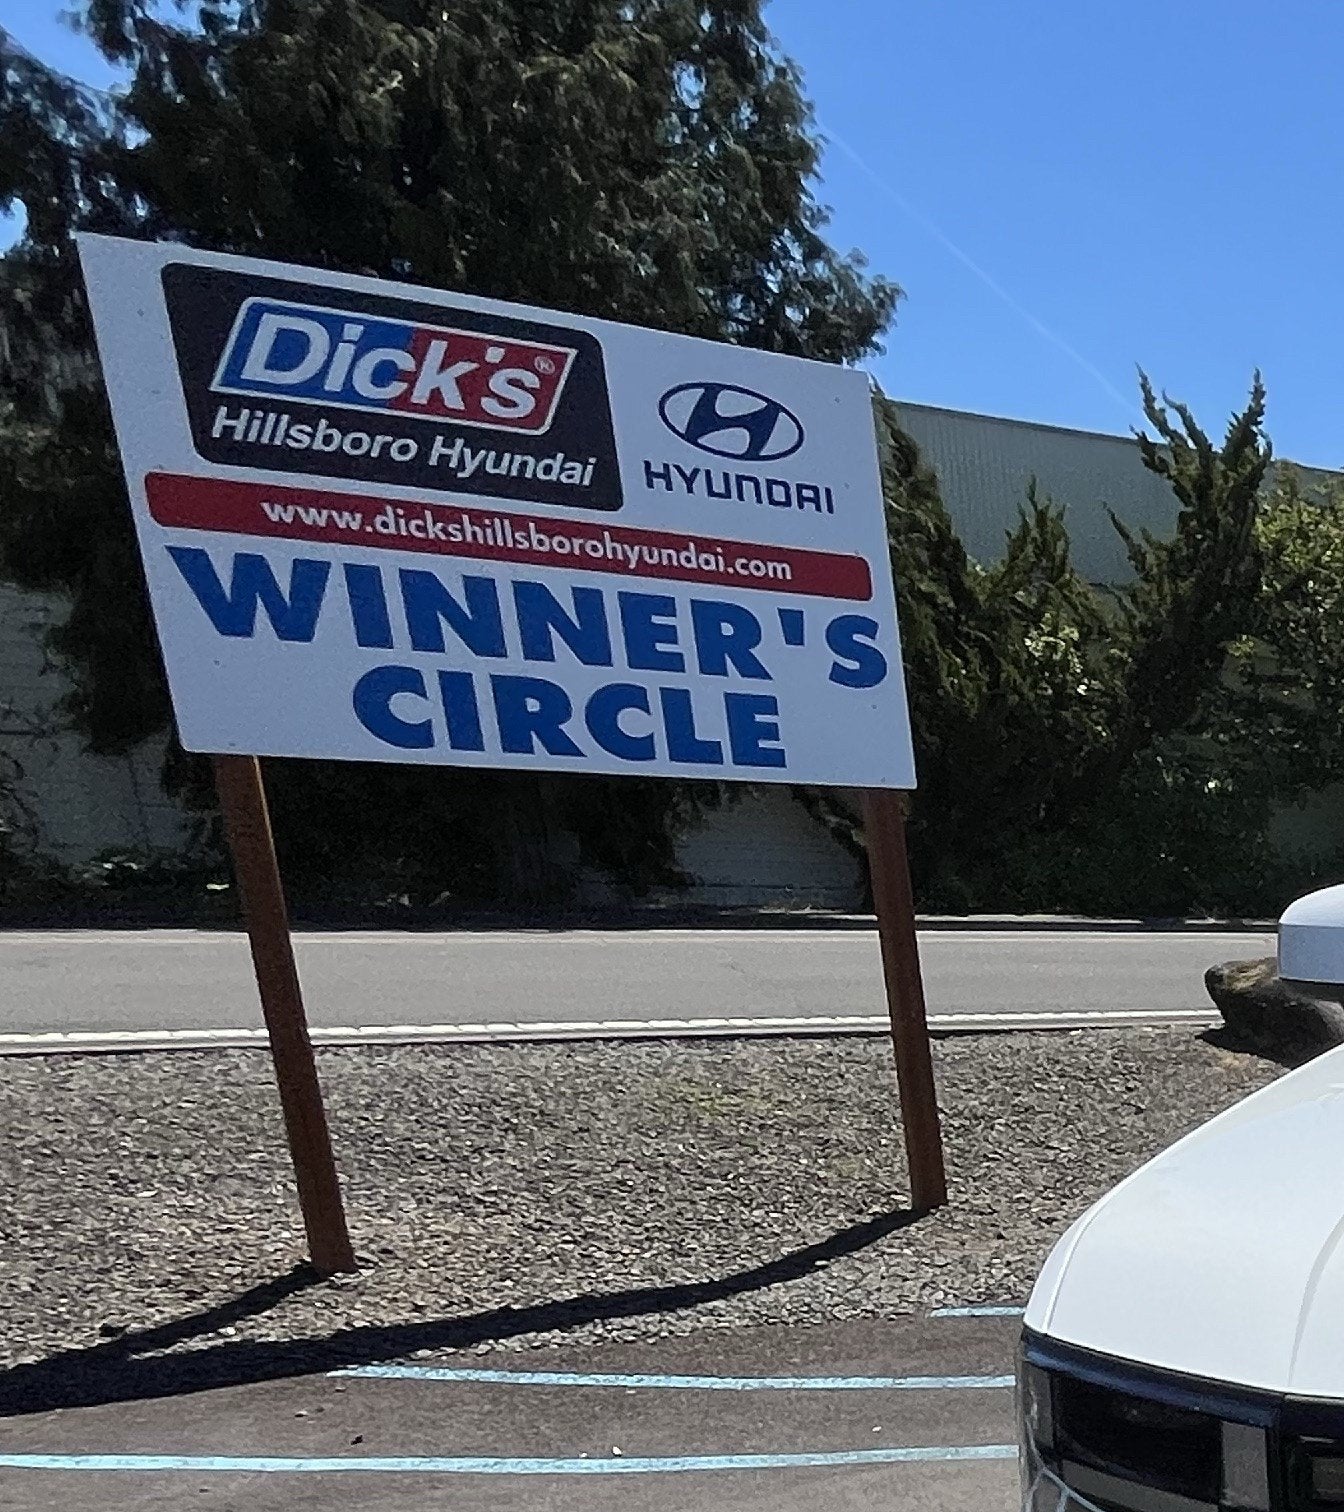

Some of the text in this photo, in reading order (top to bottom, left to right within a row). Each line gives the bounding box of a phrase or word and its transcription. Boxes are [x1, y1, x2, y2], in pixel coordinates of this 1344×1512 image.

[239, 311, 542, 421] Dick's
[211, 405, 597, 488] Hillsboro Hyundai
[644, 460, 834, 514] HYUNDAI
[261, 498, 793, 583] www.dickshillsborohyundai.com
[163, 544, 888, 689] WINNER'S
[352, 664, 787, 768] CIRCLE
